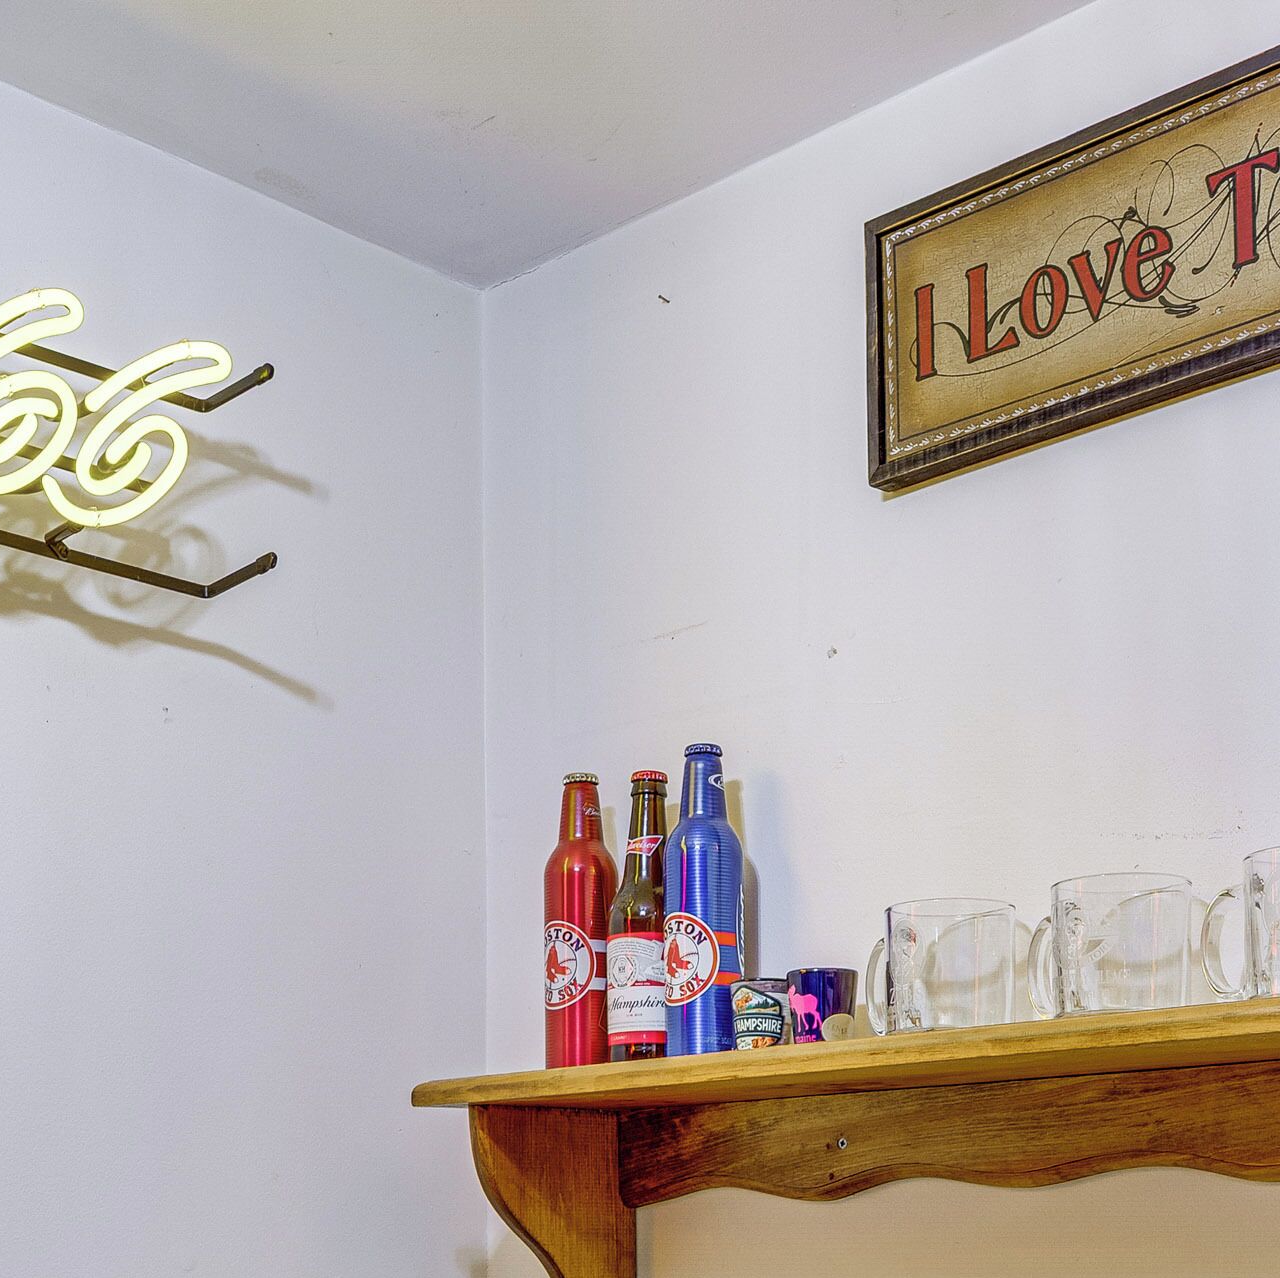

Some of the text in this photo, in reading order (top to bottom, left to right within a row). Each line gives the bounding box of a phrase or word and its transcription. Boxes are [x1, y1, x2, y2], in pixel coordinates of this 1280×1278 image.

[914, 281, 938, 382] I
[965, 225, 1177, 364] Love
[558, 976, 583, 1000] SOX
[679, 971, 705, 997] SOX
